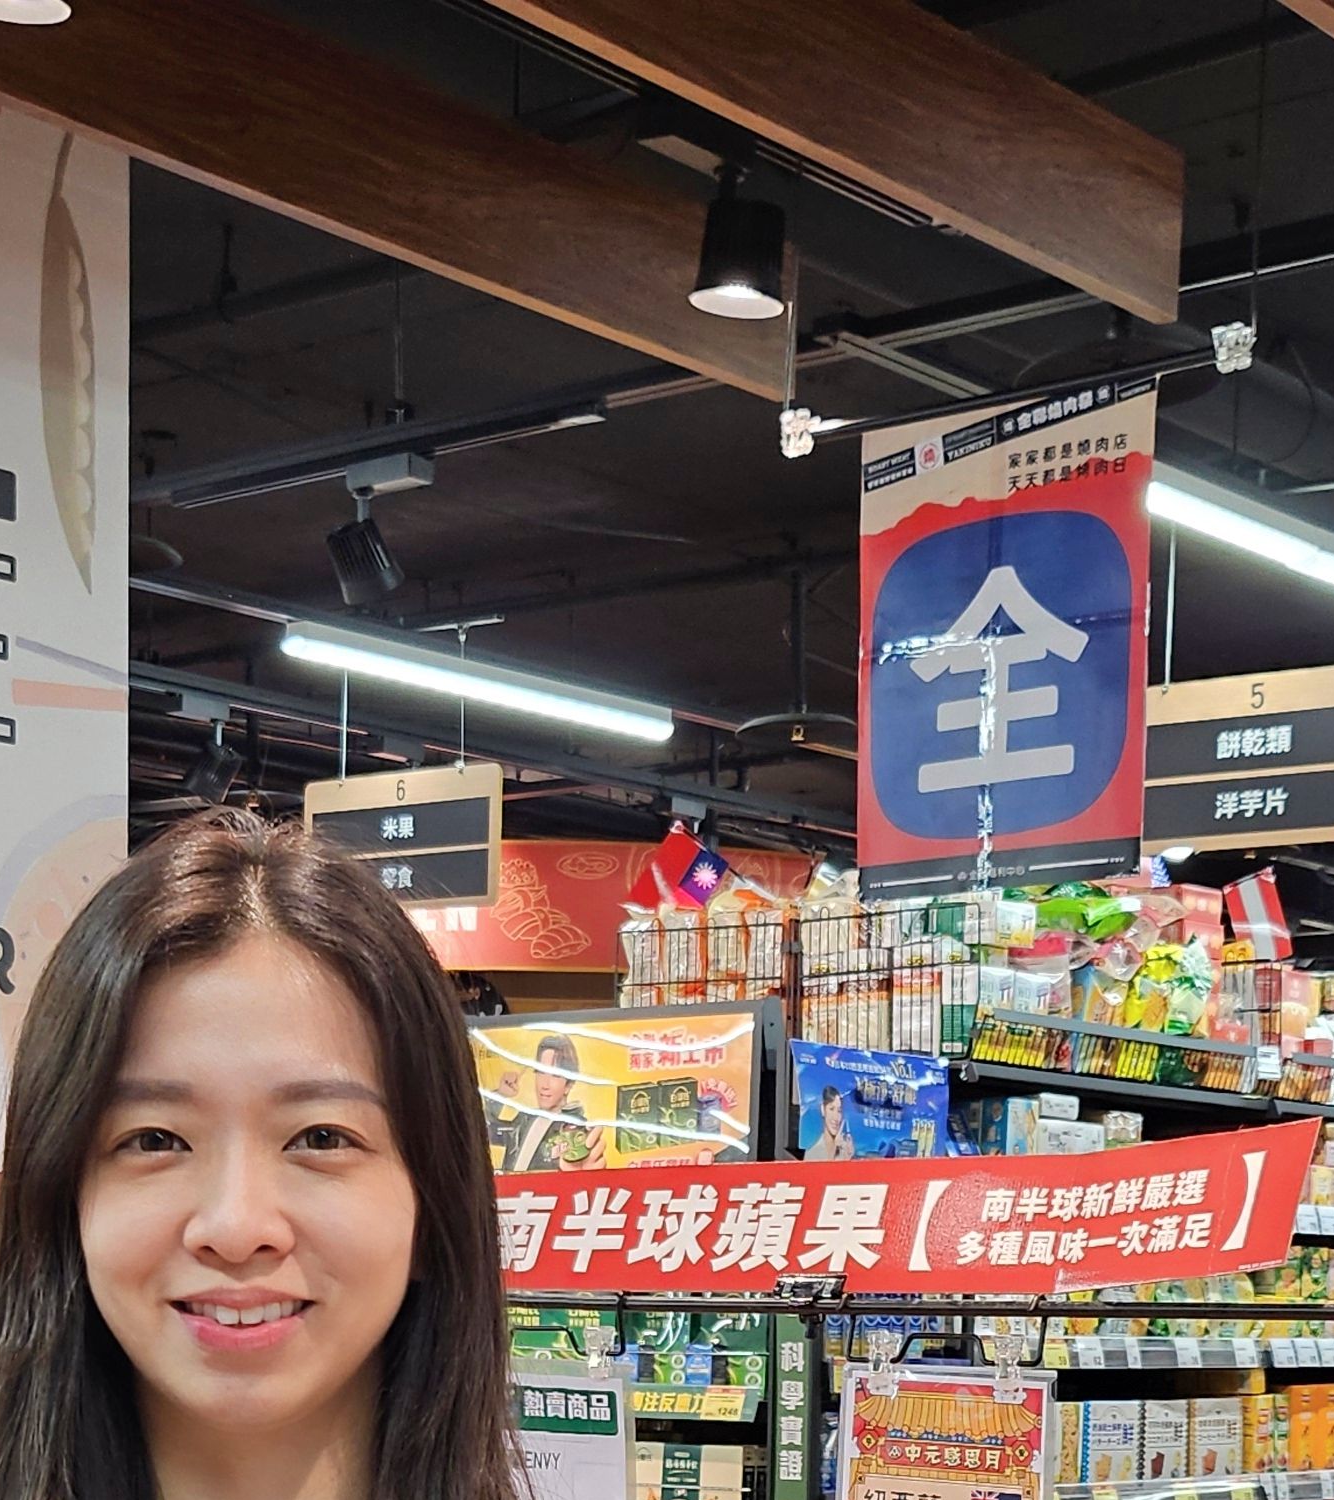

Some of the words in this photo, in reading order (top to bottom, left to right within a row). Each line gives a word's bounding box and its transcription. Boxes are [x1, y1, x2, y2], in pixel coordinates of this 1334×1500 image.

[1007, 433, 1130, 470] 家家都是燒肉店
[909, 565, 1090, 795] 全
[1249, 682, 1265, 710] 5
[1215, 725, 1294, 761] 餅乾類
[396, 779, 406, 802] 6
[1213, 788, 1290, 822] 洋芋片
[381, 815, 415, 840] 米果
[980, 1168, 1208, 1226] 南半球新鮮嚴選
[498, 1180, 891, 1274] 南半球蘋果
[955, 1210, 1213, 1268] 多種風味一次滿足
[523, 1388, 612, 1422] 熱賣商品
